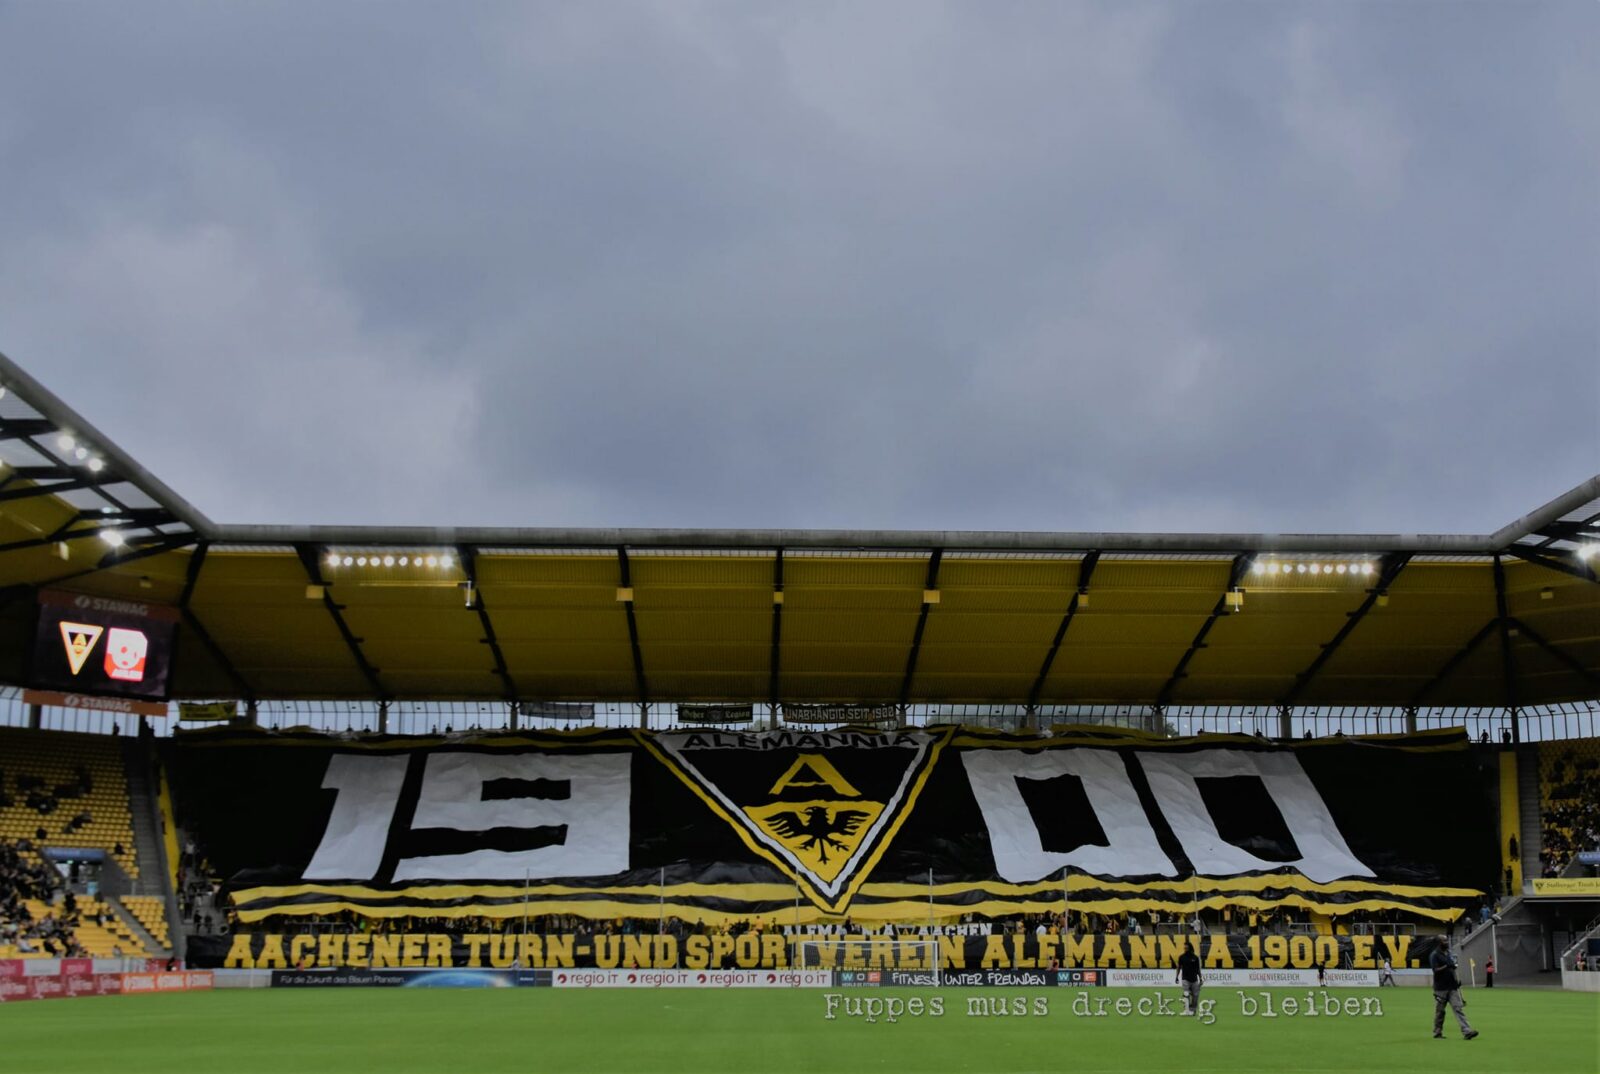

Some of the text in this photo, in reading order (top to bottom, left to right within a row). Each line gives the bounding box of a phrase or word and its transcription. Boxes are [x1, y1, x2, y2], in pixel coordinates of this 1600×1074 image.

[92, 597, 148, 617] STAWAG
[80, 696, 132, 713] STAWAG
[785, 706, 846, 720] UNABHÄNGIG
[847, 708, 869, 720] SEIT
[683, 732, 920, 749] ALEMANNIA
[919, 922, 992, 936] AACHEN
[224, 934, 453, 968] AACHENER
[1247, 935, 1339, 968] 1900
[280, 975, 292, 984] Für
[294, 976, 305, 984] die
[306, 976, 333, 984] Zukunft
[333, 976, 347, 984] des
[570, 971, 605, 987] regio
[640, 971, 675, 987] regio
[710, 971, 745, 987] regio
[780, 971, 815, 987] rego
[892, 972, 1046, 985] FITNESS UNTER FREUNDEN
